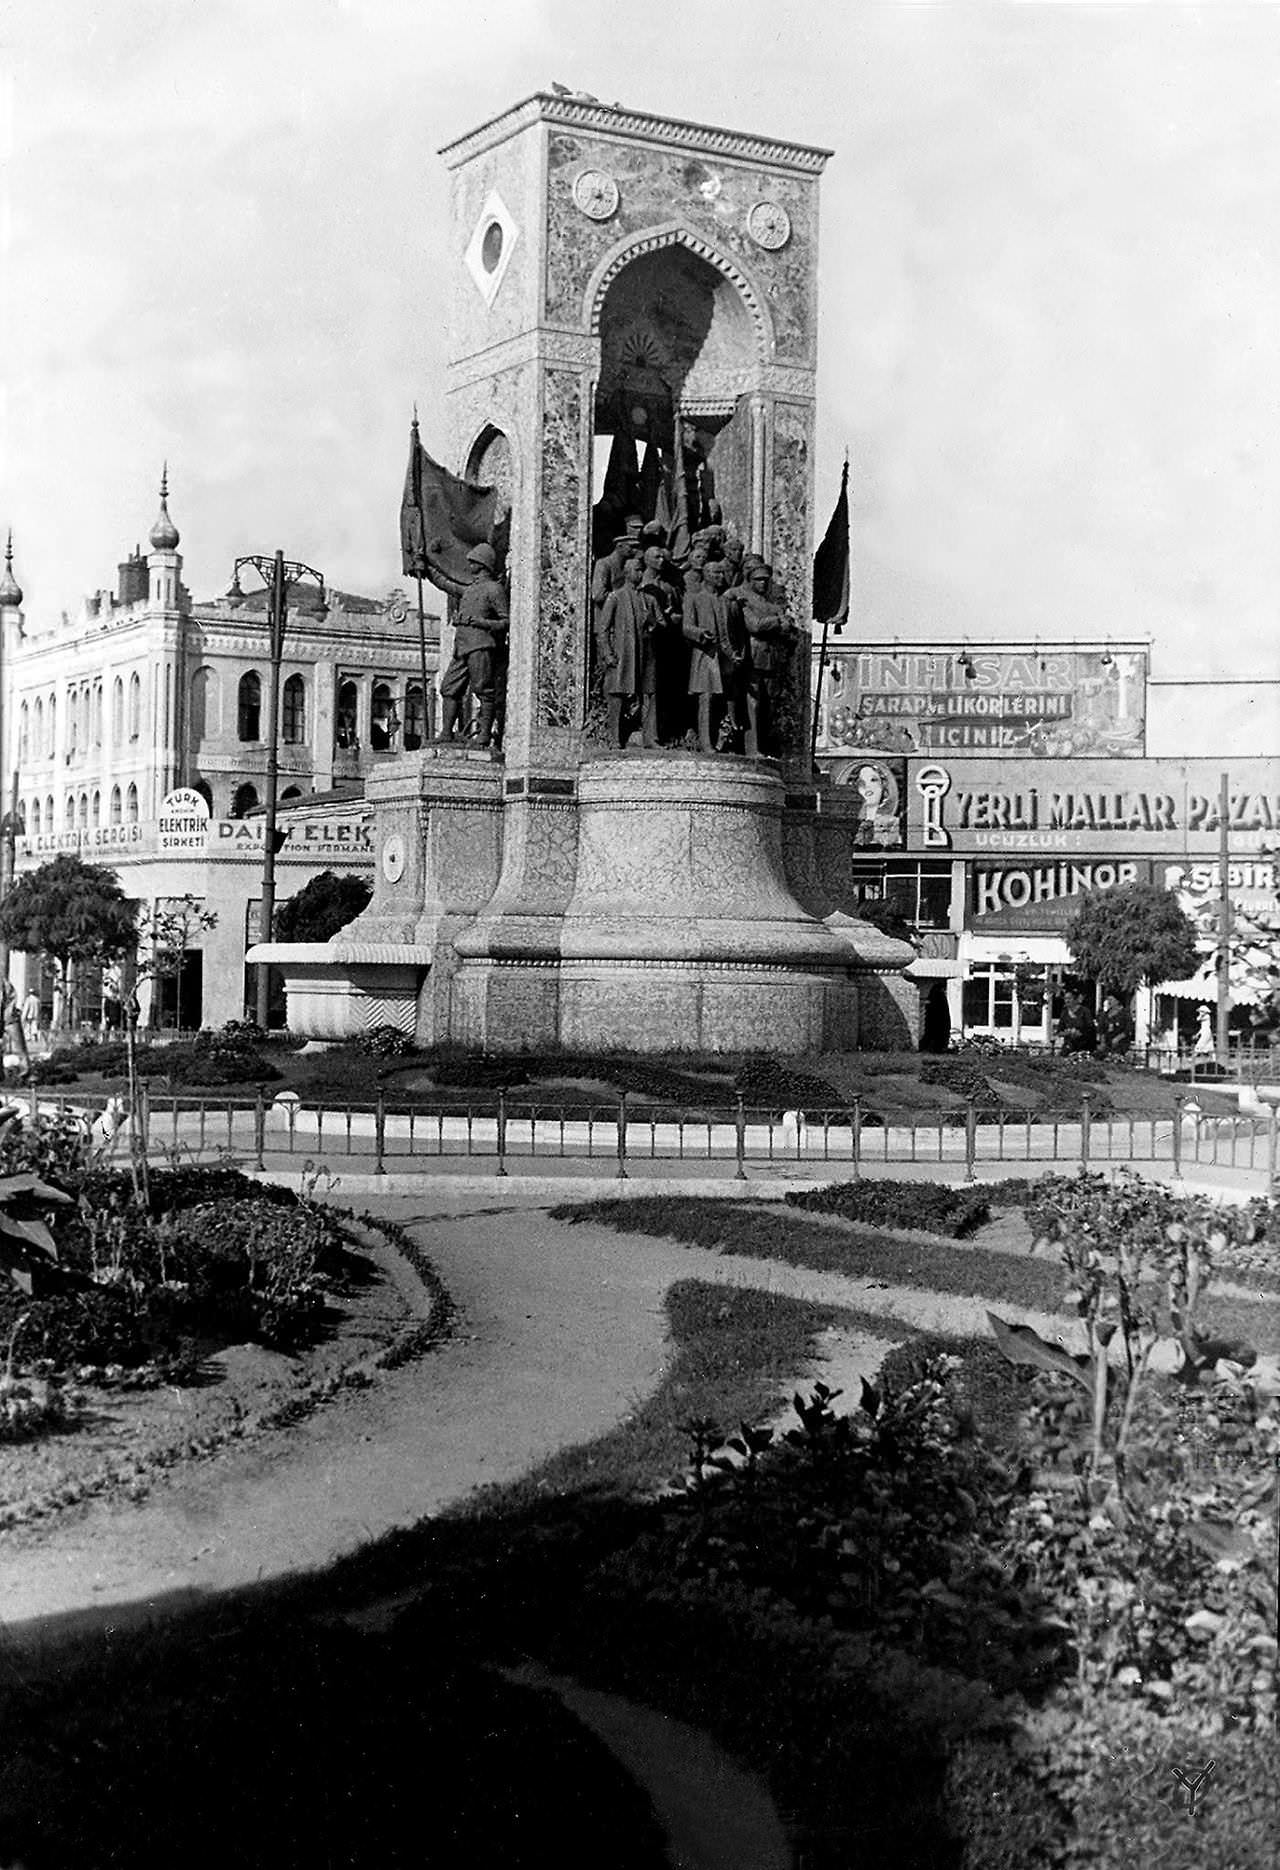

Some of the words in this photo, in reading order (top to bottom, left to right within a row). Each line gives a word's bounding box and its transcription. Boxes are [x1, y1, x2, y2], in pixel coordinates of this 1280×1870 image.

[956, 788, 1038, 831] YERLİ
[1049, 792, 1178, 831] MALLAR
[1188, 792, 1280, 832] PAZA
[305, 824, 377, 847] ELEK
